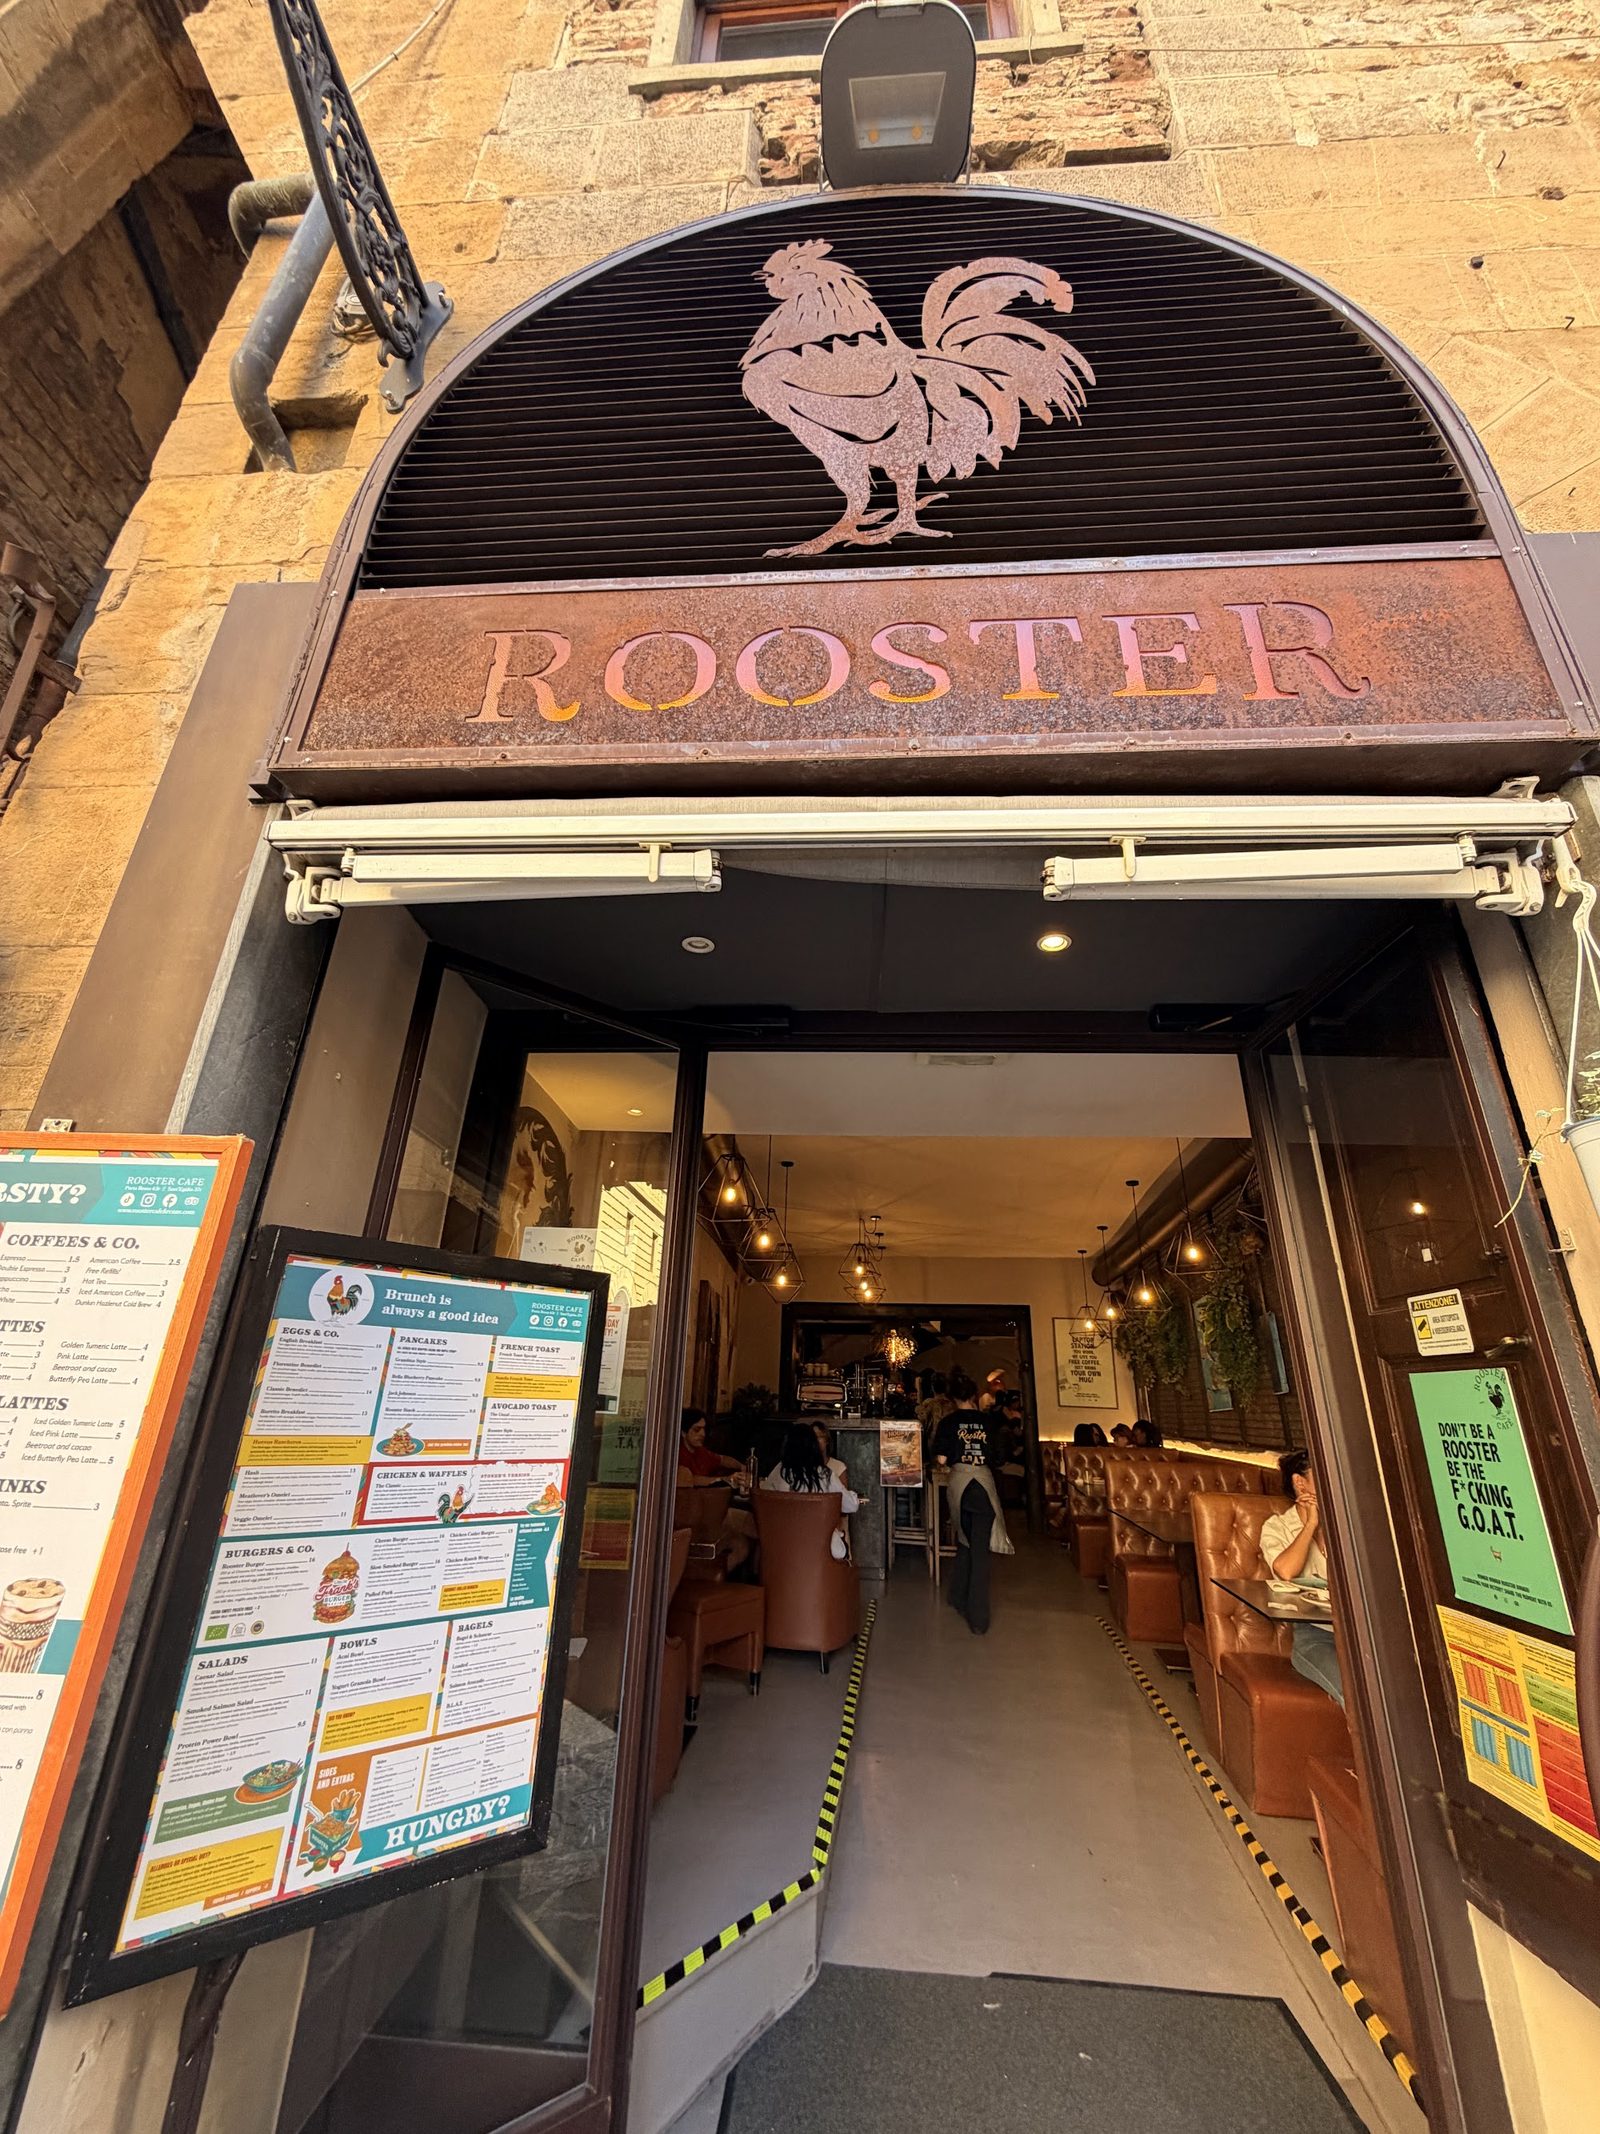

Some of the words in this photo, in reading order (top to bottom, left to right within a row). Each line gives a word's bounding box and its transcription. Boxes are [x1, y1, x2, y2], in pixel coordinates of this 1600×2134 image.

[465, 602, 1371, 724] ROOSTER
[127, 1176, 174, 1185] ROOSTER
[178, 1178, 205, 1186] CAFE
[7, 1234, 90, 1248] COFFEES
[94, 1237, 107, 1249] &
[112, 1237, 140, 1250] CO.
[567, 1235, 595, 1245] ROOSTER
[0, 1254, 26, 1262] Espresso
[79, 1288, 93, 1297] Iced
[384, 1288, 437, 1304] Brunch
[439, 1294, 452, 1306] is
[532, 1302, 564, 1312] ROOSTER
[565, 1305, 583, 1314] CAFE
[1414, 1296, 1457, 1310] ATTENZIONE!
[381, 1304, 425, 1318] always
[429, 1310, 436, 1318] a
[439, 1310, 469, 1322] good
[473, 1313, 499, 1325] idea
[282, 1327, 311, 1336] EGGS
[313, 1329, 321, 1337] &
[324, 1330, 340, 1338] CO.
[60, 1341, 84, 1349] Golden
[86, 1342, 110, 1350] Tumeric
[111, 1342, 128, 1351] Latte
[399, 1336, 448, 1345] PANCAKES
[500, 1343, 534, 1352] FRENCH
[535, 1346, 560, 1354] TOAST
[52, 1364, 81, 1372] Beetroot
[49, 1376, 76, 1384] Butterfly
[77, 1376, 90, 1384] Pea
[491, 1403, 530, 1411] AVOCADO
[531, 1403, 557, 1411] TOAST
[33, 1417, 48, 1425] Iced
[49, 1418, 72, 1426] Golden
[73, 1419, 96, 1427] Tumeric
[97, 1420, 114, 1428] Latte
[119, 1420, 125, 1428] 5
[30, 1429, 45, 1437] Iced
[46, 1430, 60, 1438] Pink
[62, 1431, 79, 1439] Latte
[115, 1432, 121, 1440] 5
[1438, 1422, 1468, 1439] DON'T
[1470, 1424, 1484, 1439] BE
[1487, 1424, 1495, 1440] A
[25, 1441, 53, 1450] Beetroot
[1442, 1440, 1501, 1463] ROOSTER
[37, 1455, 65, 1464] Butterfly
[66, 1455, 79, 1463] Pea
[81, 1456, 98, 1464] Latte
[108, 1456, 114, 1465] 5
[377, 1471, 419, 1480] CHICKEN
[429, 1470, 468, 1478] WAFFLES
[1447, 1461, 1462, 1478] BE
[1462, 1462, 1486, 1481] THE
[12, 1499, 32, 1508] Sprite
[93, 1503, 100, 1511] 3
[1457, 1503, 1525, 1542] G.O.A.T.
[13, 1545, 28, 1555] free
[225, 1547, 283, 1559] BURGERS
[285, 1546, 294, 1554] &
[297, 1545, 315, 1553] CO.
[457, 1621, 494, 1633] BAGELS
[339, 1637, 378, 1650] BOWLS
[197, 1655, 249, 1670] SALADS
[36, 1689, 44, 1700] 8
[186, 1705, 212, 1715] Smoked
[213, 1702, 236, 1711] Salmon
[236, 1699, 254, 1707] Salad
[177, 1740, 201, 1750] Protein
[202, 1737, 223, 1746] Power
[223, 1733, 239, 1742] Bowl
[15, 1759, 24, 1770] 8
[318, 1767, 338, 1780] SIDES
[316, 1778, 331, 1790] AND
[332, 1773, 355, 1787] EXTRAS
[384, 1794, 511, 1850] HUNGRY?
